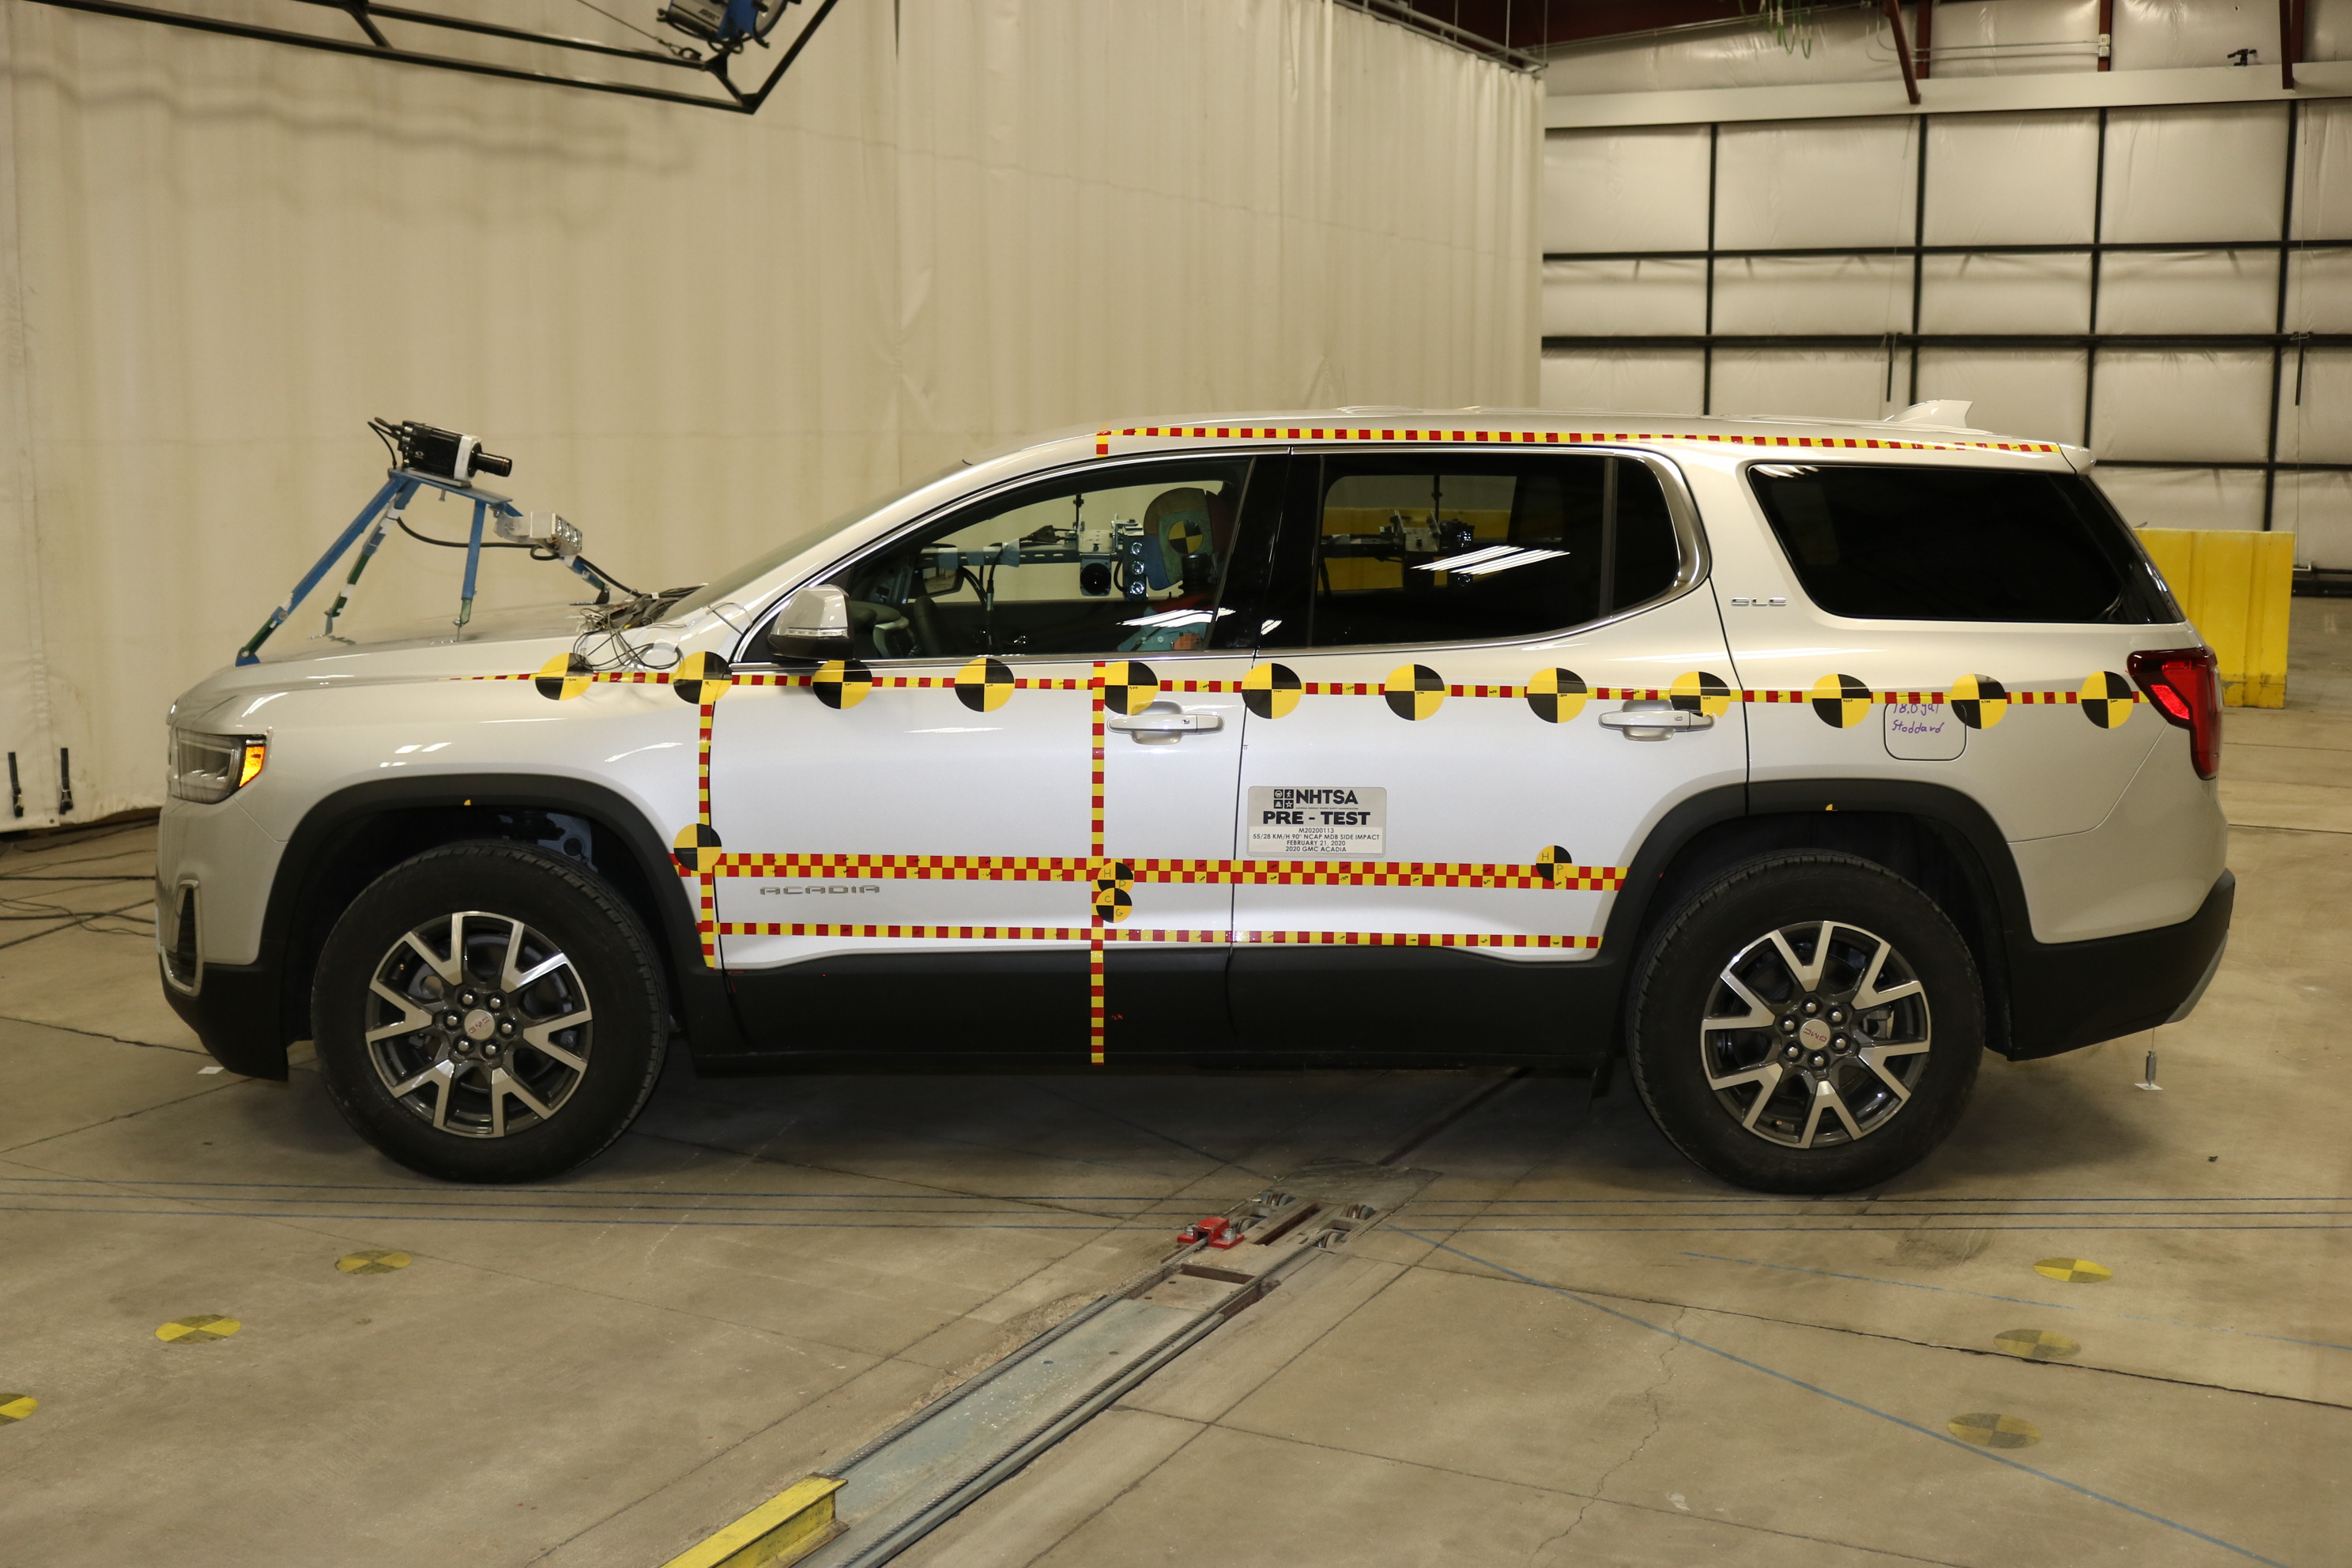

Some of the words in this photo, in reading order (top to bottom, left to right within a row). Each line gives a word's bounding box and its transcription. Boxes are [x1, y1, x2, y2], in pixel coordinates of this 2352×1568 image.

[1731, 597, 1787, 607] SLE
[1892, 719, 1945, 734] Stoddard
[1295, 790, 1359, 805] NHTSA
[1263, 811, 1303, 824] PRE
[1321, 812, 1370, 825] TEST
[1542, 853, 1549, 861] H
[1103, 869, 1111, 878] H
[760, 884, 880, 895] ACADIA
[468, 1016, 491, 1035] GMC
[1802, 1027, 1828, 1042] GMC
